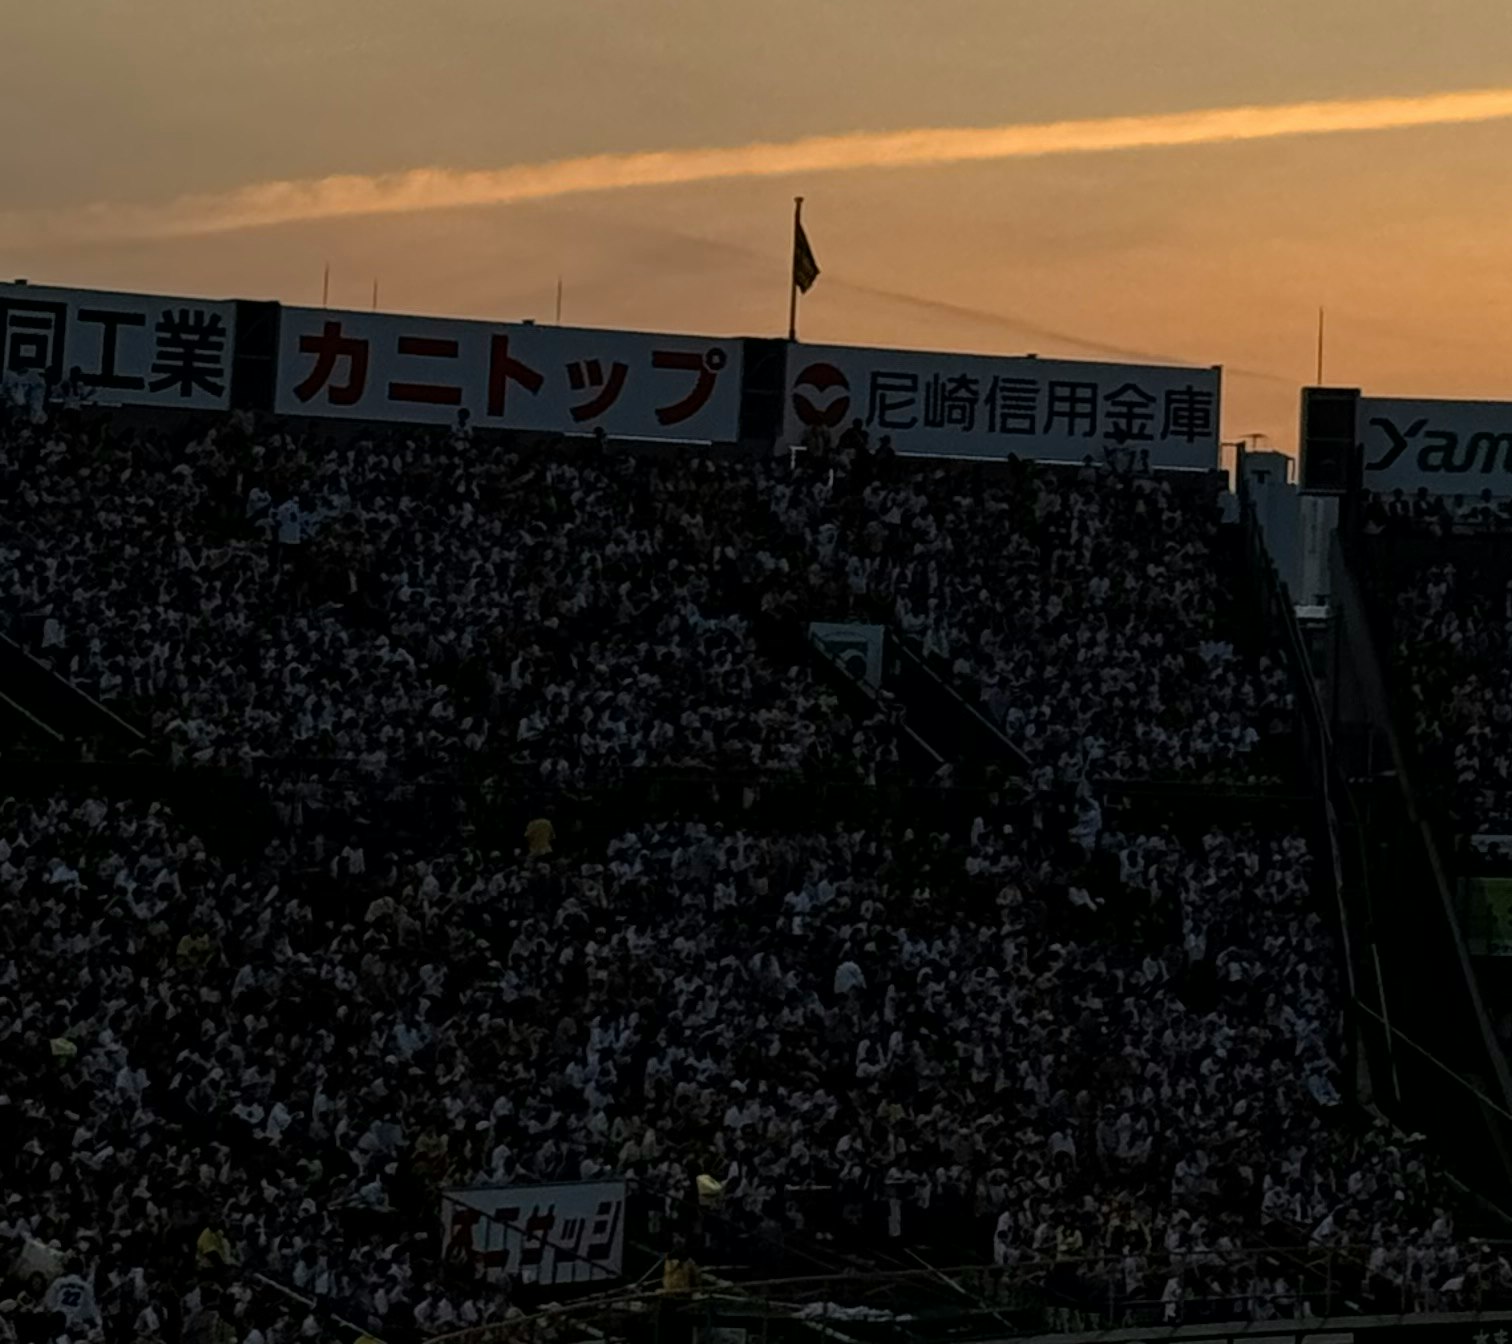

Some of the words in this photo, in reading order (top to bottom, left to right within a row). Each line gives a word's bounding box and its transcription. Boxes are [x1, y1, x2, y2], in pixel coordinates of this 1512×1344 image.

[294, 321, 727, 426] カニトップ
[866, 370, 1213, 443] 尼崎信用金庫
